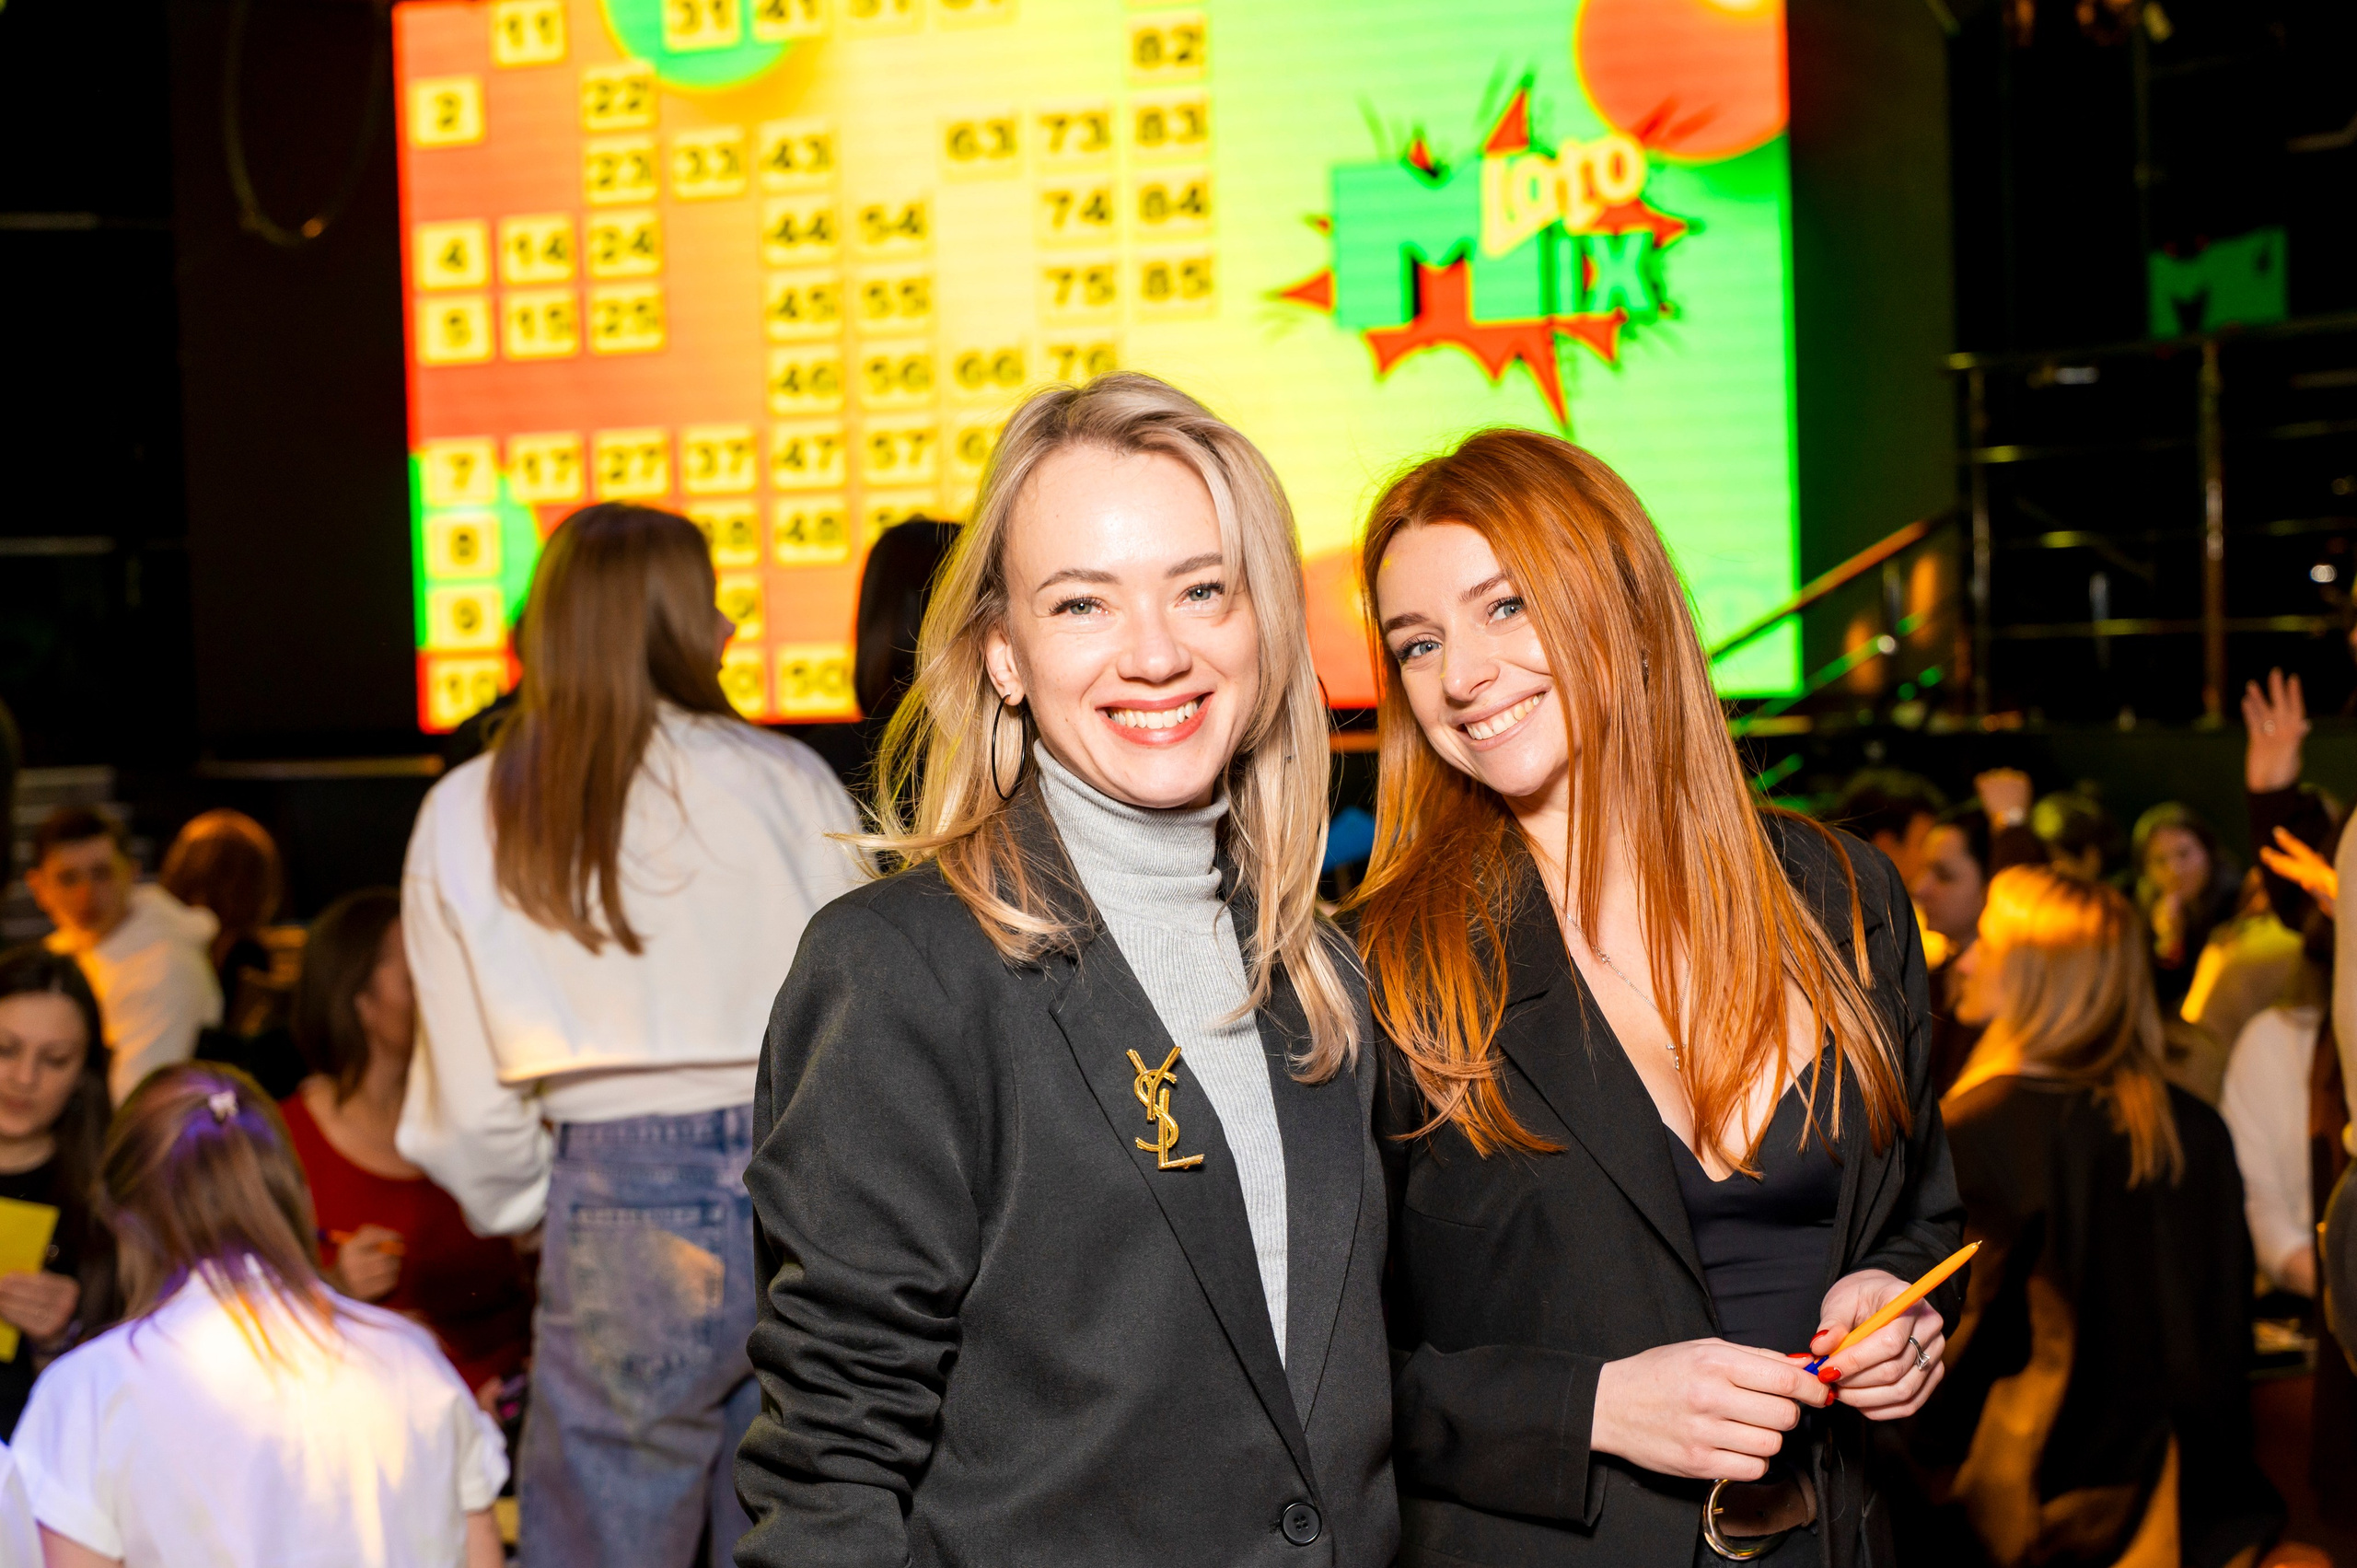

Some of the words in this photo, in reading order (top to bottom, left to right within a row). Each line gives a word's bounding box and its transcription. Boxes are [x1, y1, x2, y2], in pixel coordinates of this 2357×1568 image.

[504, 10, 556, 48] 11
[436, 93, 461, 131] 2
[588, 77, 651, 114] 22
[1133, 26, 1205, 67] 82
[590, 152, 654, 189] 23
[679, 145, 744, 182] 33
[762, 136, 834, 172] 43
[946, 120, 1016, 160] 63
[1039, 111, 1111, 152] 73
[1135, 104, 1208, 145] 83
[440, 238, 468, 273] 4
[509, 230, 572, 266] 14
[594, 226, 656, 264] 24
[764, 210, 839, 247] 44
[859, 203, 928, 242] 54
[1042, 189, 1114, 228] 74
[1138, 181, 1210, 223] 84
[444, 309, 470, 346] 5
[513, 307, 575, 343] 15
[597, 300, 660, 340] 25
[766, 285, 840, 322] 45
[862, 277, 931, 318] 55
[1044, 264, 1116, 305] 75
[1142, 259, 1213, 300] 85
[770, 363, 841, 400] 46
[863, 354, 935, 393] 56
[954, 349, 1025, 388] 66
[1048, 343, 1118, 382] 76
[448, 452, 475, 488] 7
[519, 448, 576, 486] 17
[601, 446, 665, 483] 27
[691, 442, 752, 480] 37
[772, 434, 842, 470] 47
[865, 426, 934, 466] 57
[450, 527, 478, 564] 8
[777, 509, 844, 547] 48
[452, 599, 482, 635] 9
[441, 669, 499, 709] 10
[785, 661, 851, 700] 50
[1126, 1046, 1205, 1170] YSL
